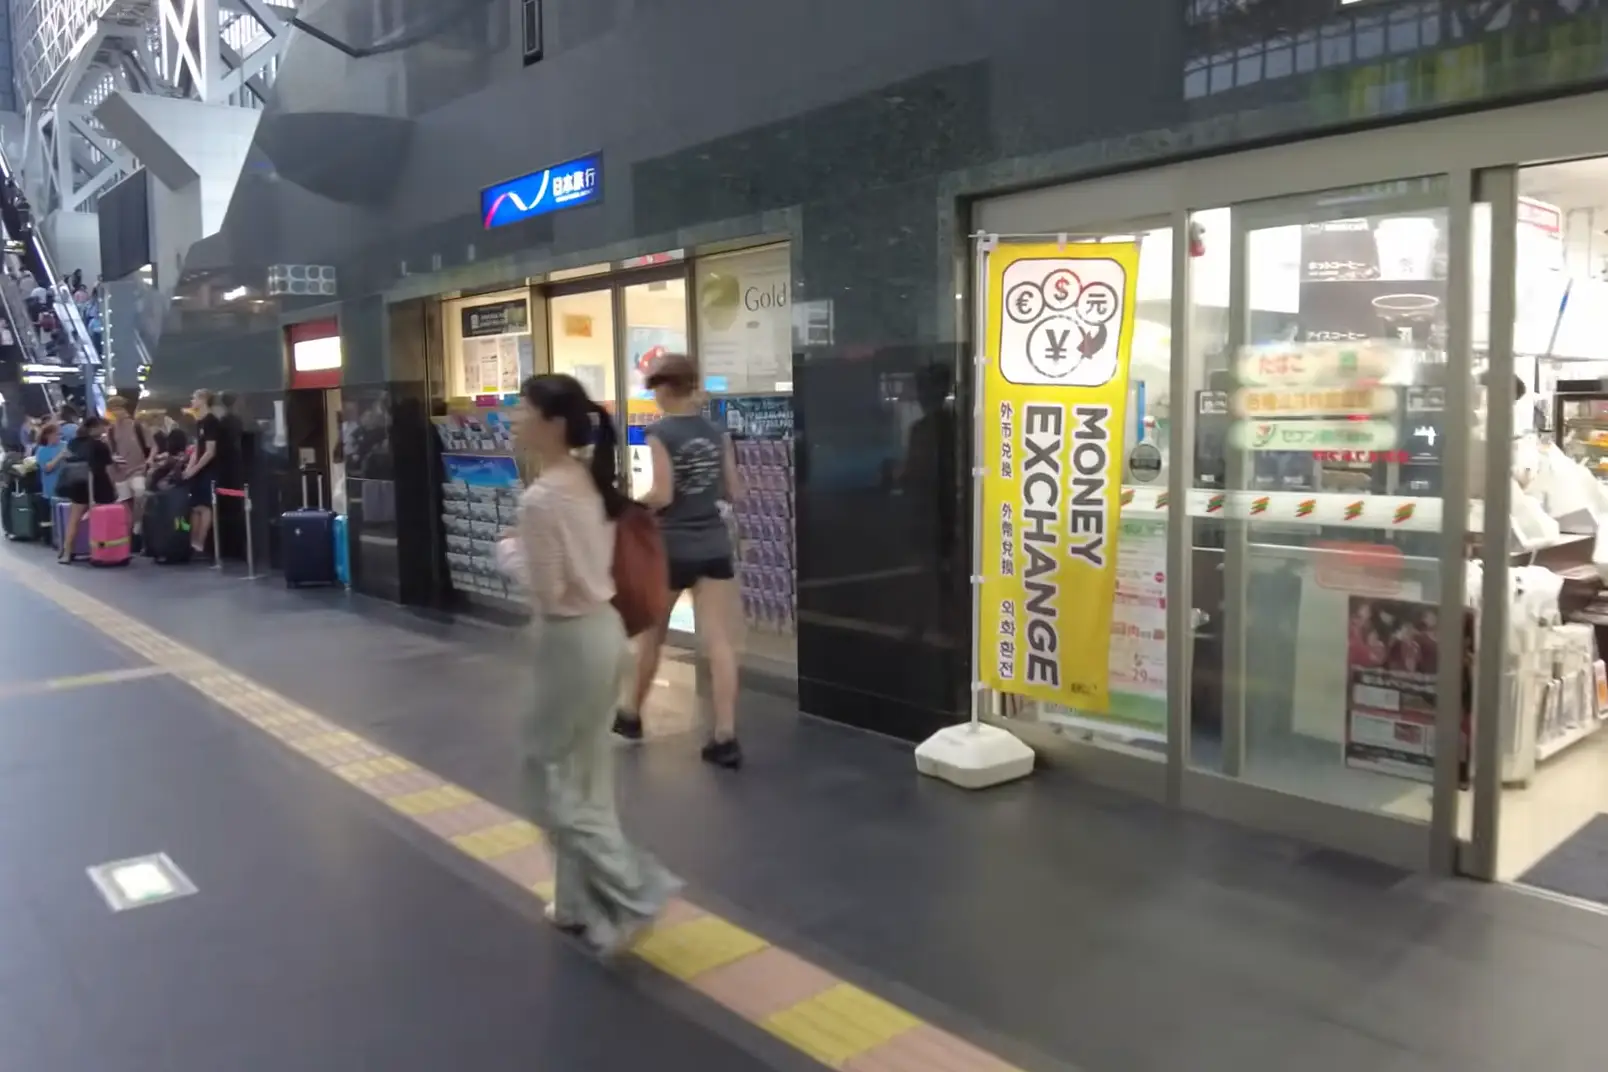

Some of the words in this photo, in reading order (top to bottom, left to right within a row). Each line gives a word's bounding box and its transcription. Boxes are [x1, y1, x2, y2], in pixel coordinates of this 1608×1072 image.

[744, 282, 787, 311] Gold
[1086, 293, 1108, 315] 元
[1071, 407, 1109, 566] MONEY
[1023, 405, 1063, 687] EXCHANGE
